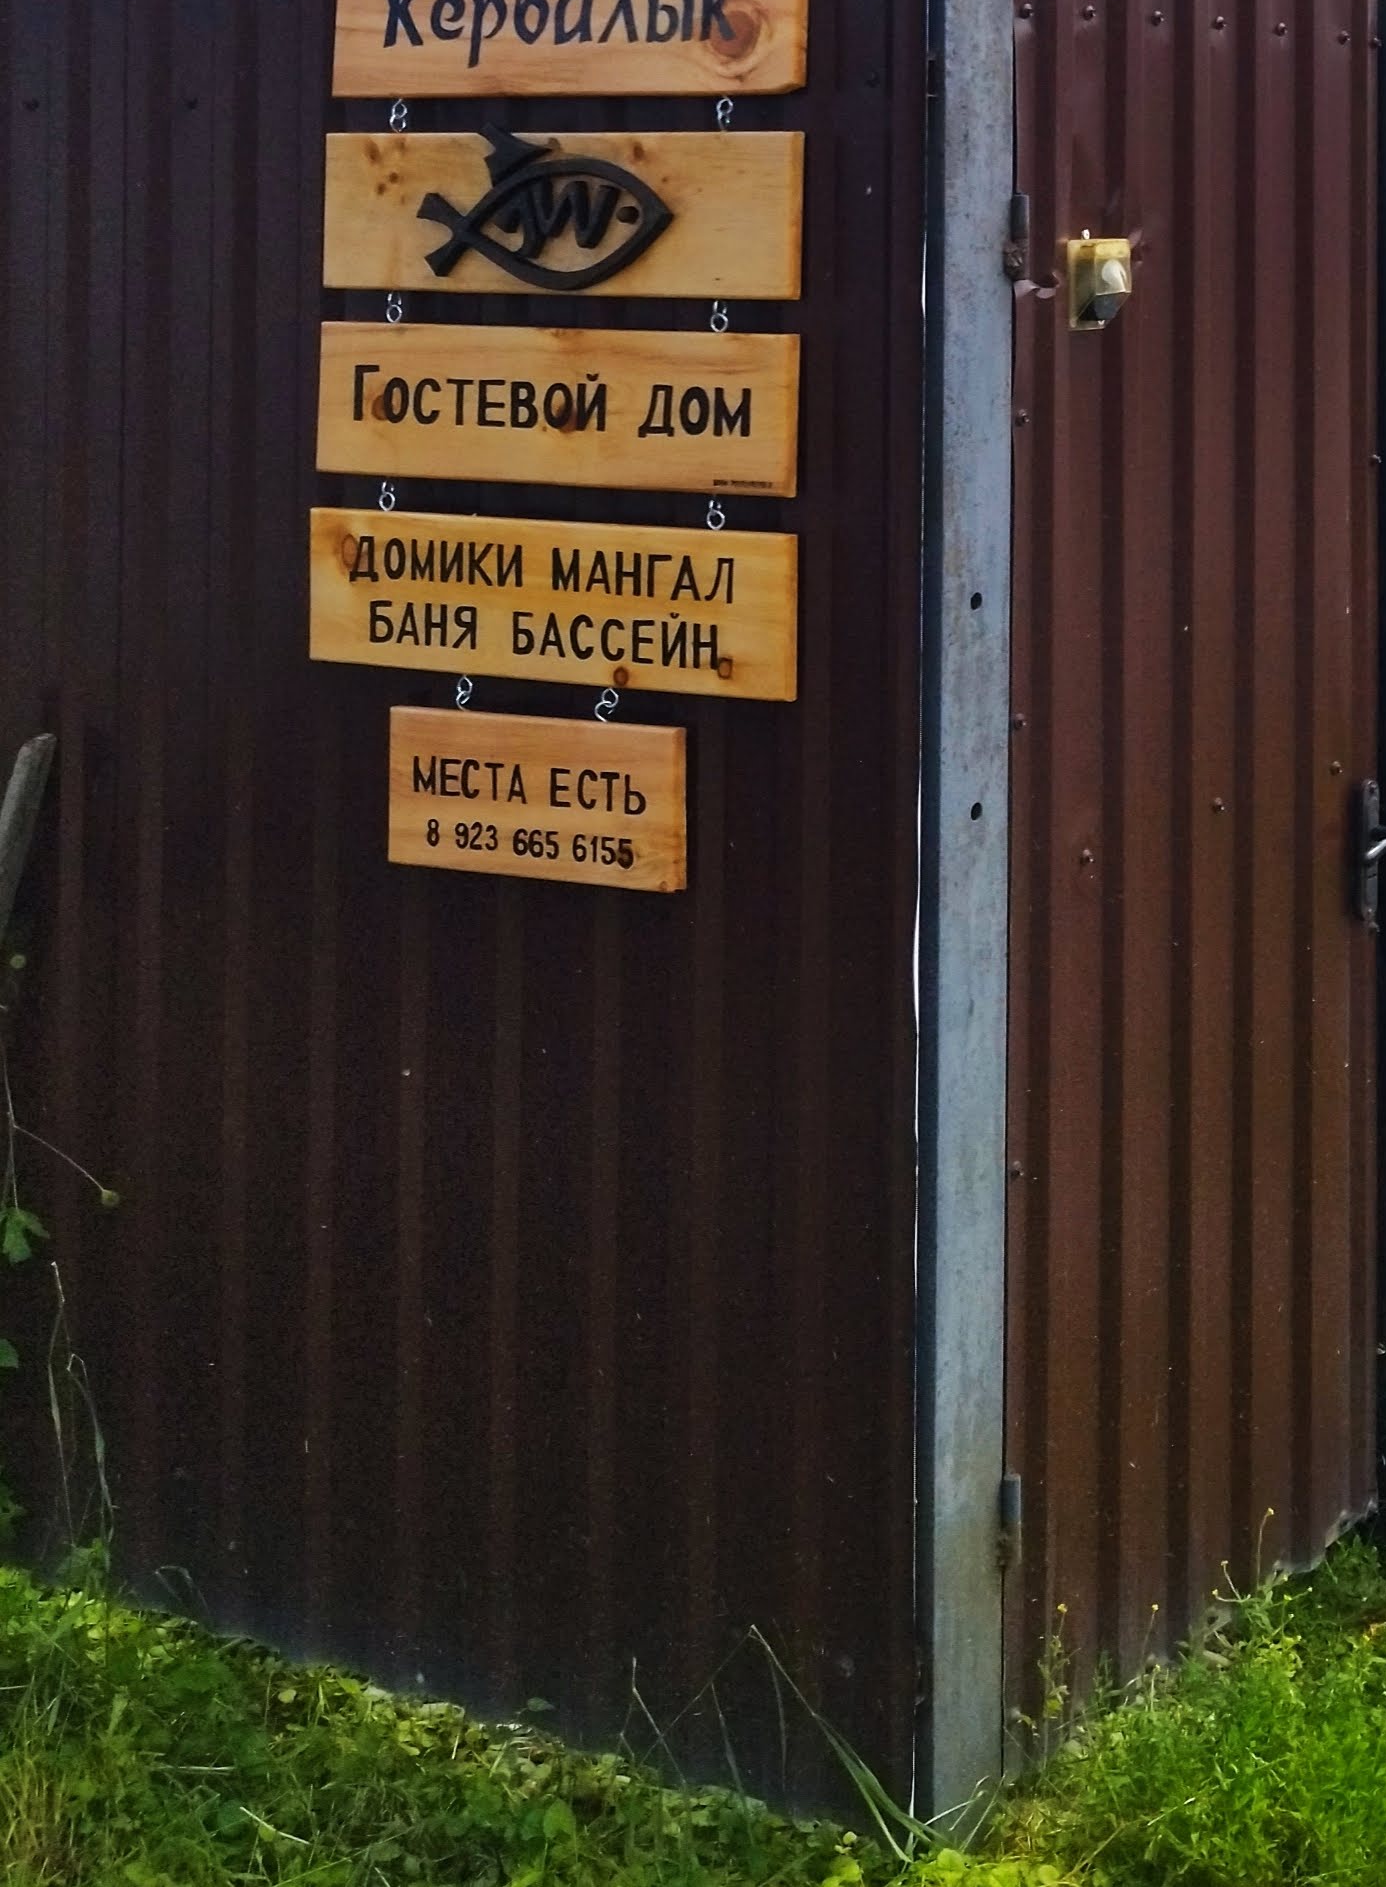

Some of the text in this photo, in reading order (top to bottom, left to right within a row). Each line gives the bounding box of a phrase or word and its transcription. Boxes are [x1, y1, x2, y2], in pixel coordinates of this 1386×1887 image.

[349, 535, 735, 604] ДОМИКИ МАНГАЛ
[369, 600, 719, 670] БАНЯ БАССЕЙН
[412, 755, 647, 815] МЕСТА ЕСТЬ
[425, 818, 634, 870] 8 923 665 6155
